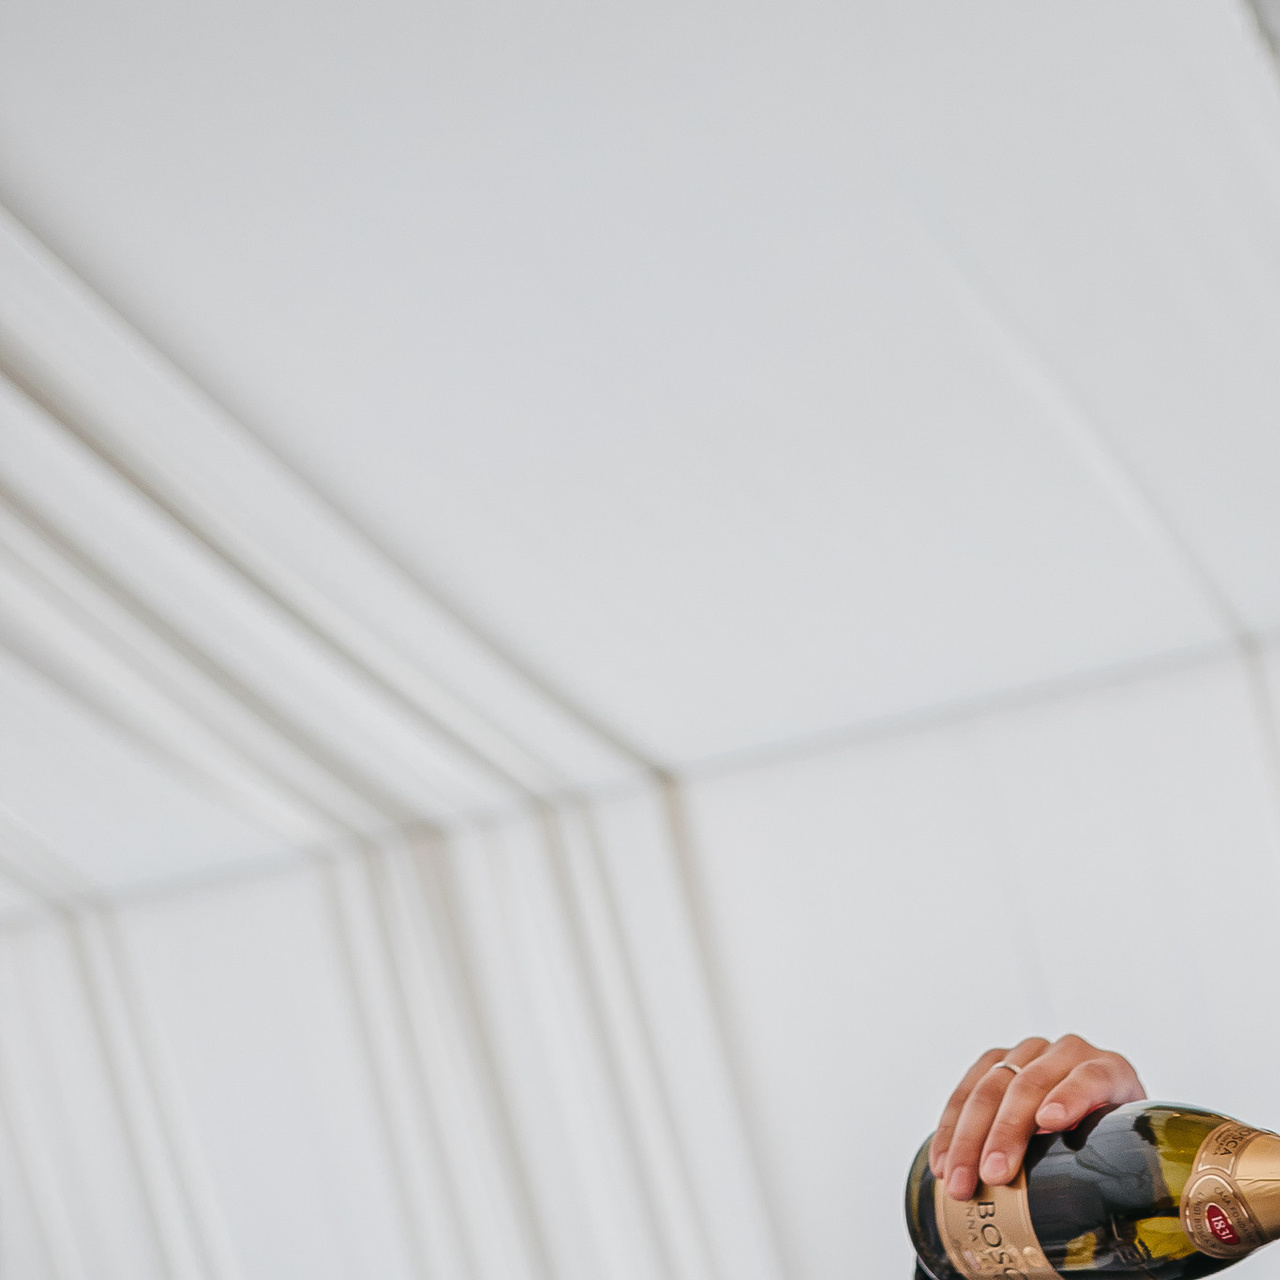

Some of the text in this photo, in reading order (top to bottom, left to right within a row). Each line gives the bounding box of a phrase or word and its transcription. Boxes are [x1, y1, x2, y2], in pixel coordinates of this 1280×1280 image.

[1219, 1128, 1252, 1156] OSCA
[965, 1205, 979, 1242] NNA
[1211, 1215, 1233, 1241] 1831
